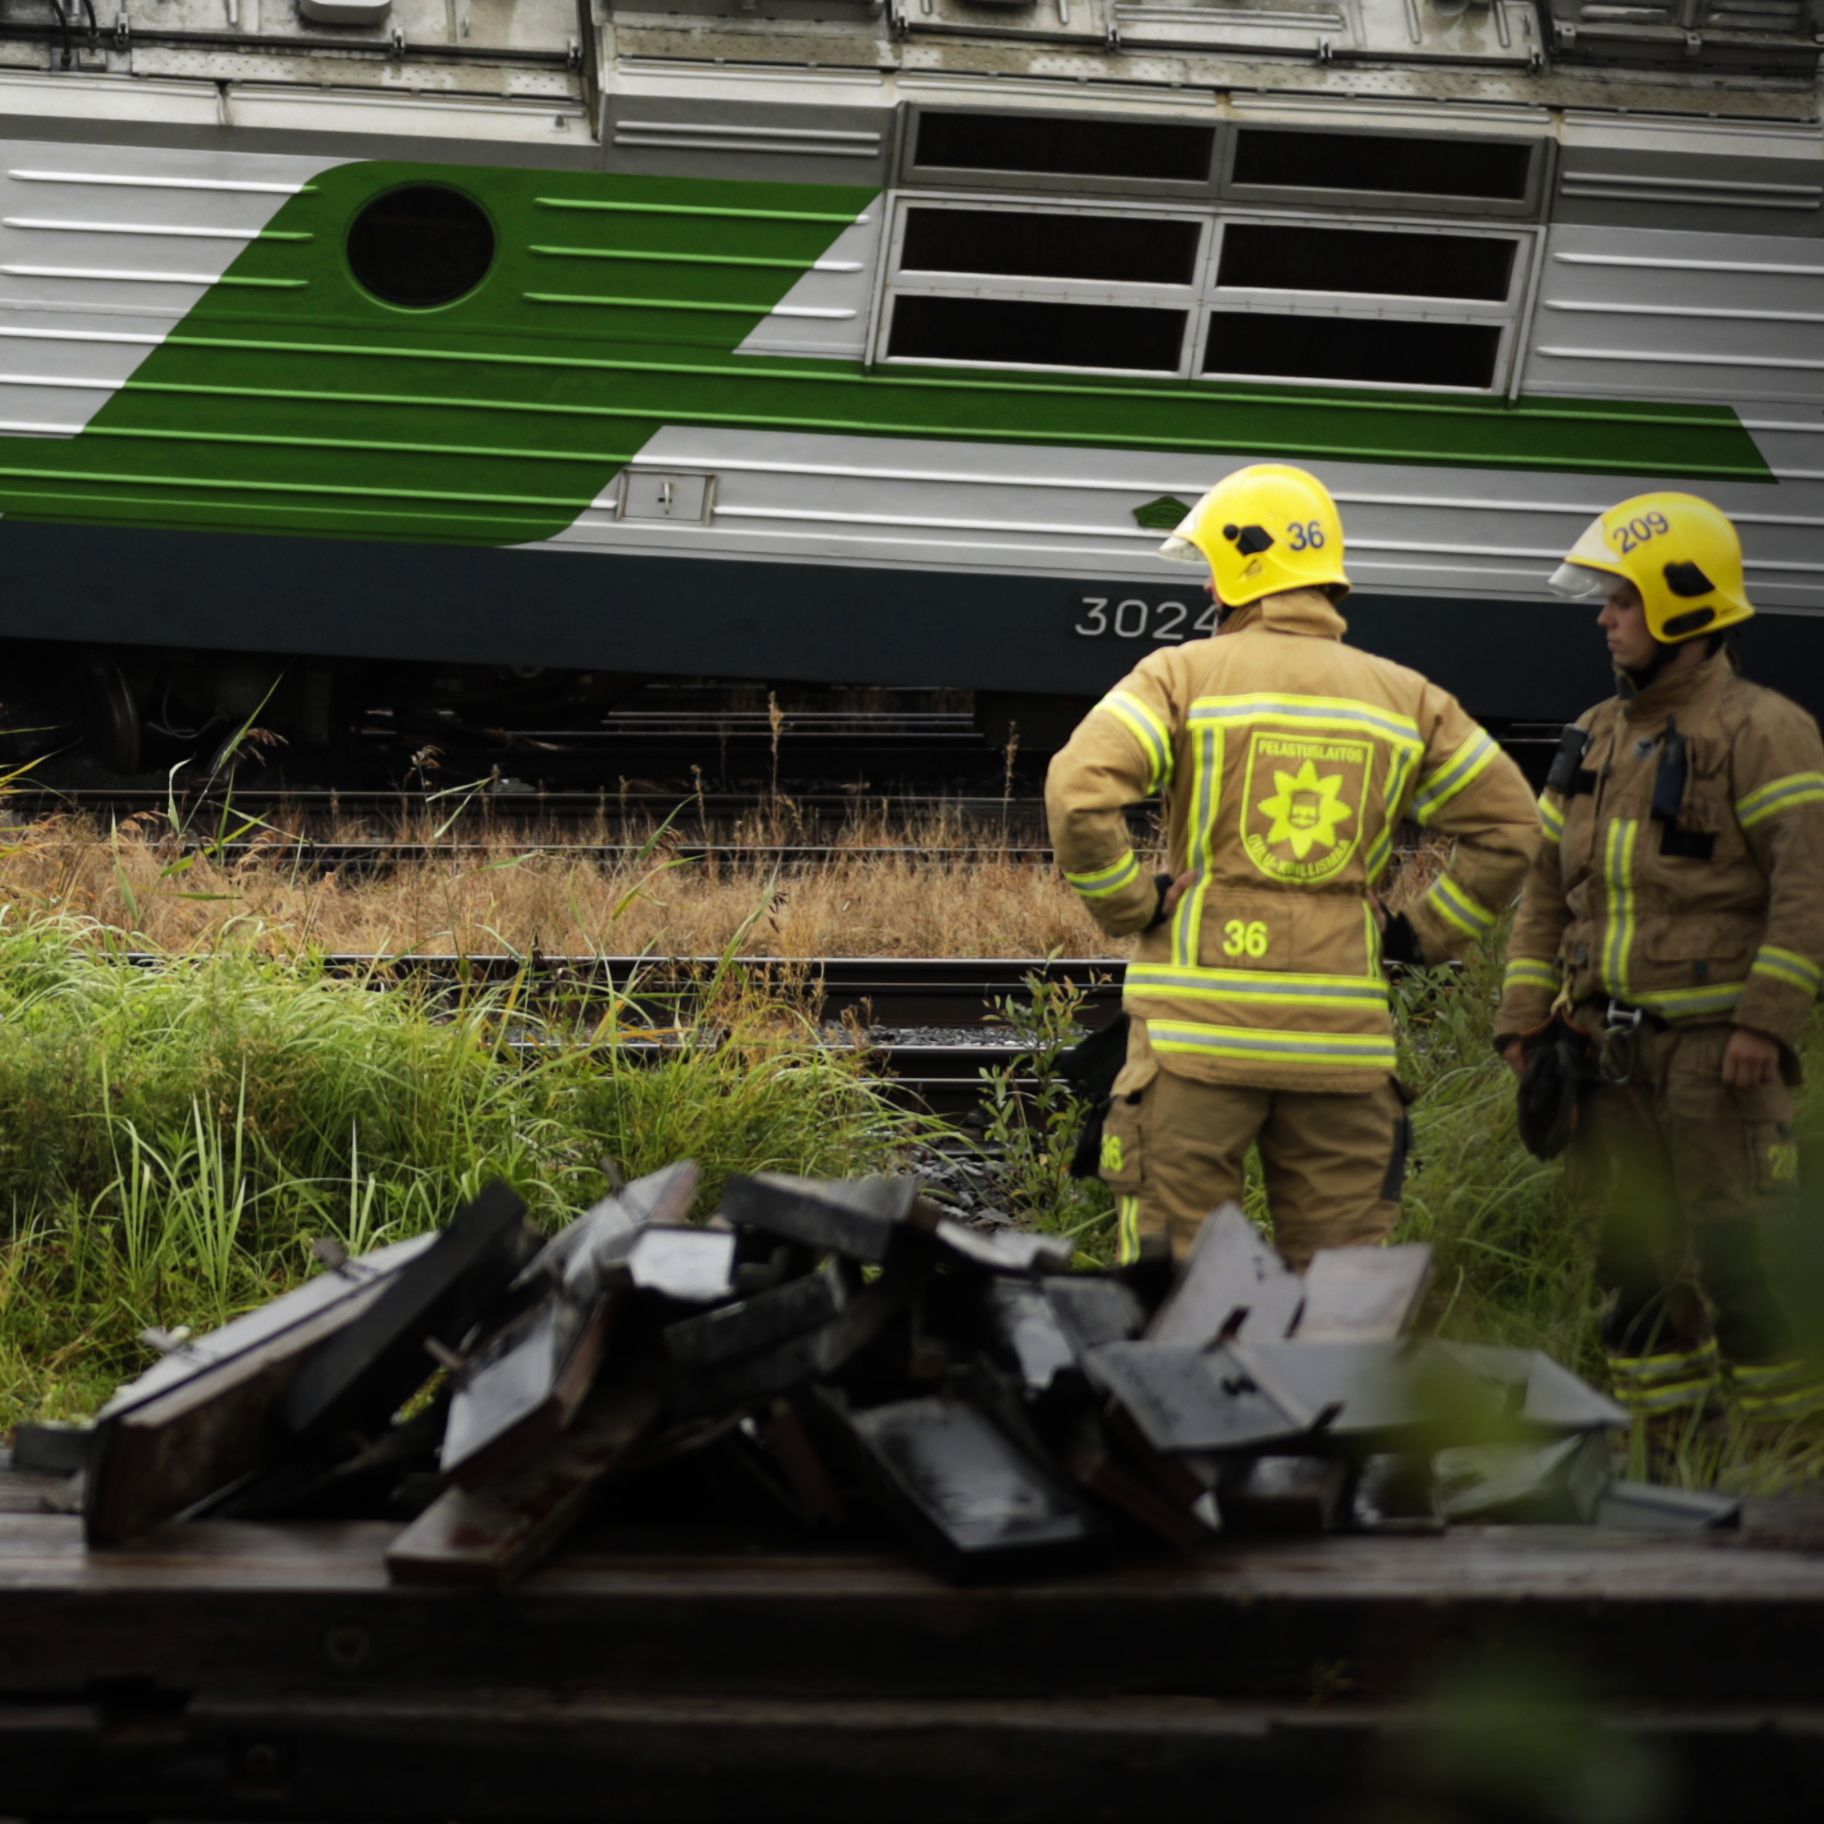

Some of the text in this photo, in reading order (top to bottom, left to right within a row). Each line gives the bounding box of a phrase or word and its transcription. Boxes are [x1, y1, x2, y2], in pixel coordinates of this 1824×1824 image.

[1286, 520, 1326, 552] 36
[1612, 511, 1669, 555] 209
[1257, 738, 1364, 764] PELASTUSLAITOS
[1246, 833, 1353, 877] OULU-KOILLISMAA
[1222, 918, 1269, 959] 36
